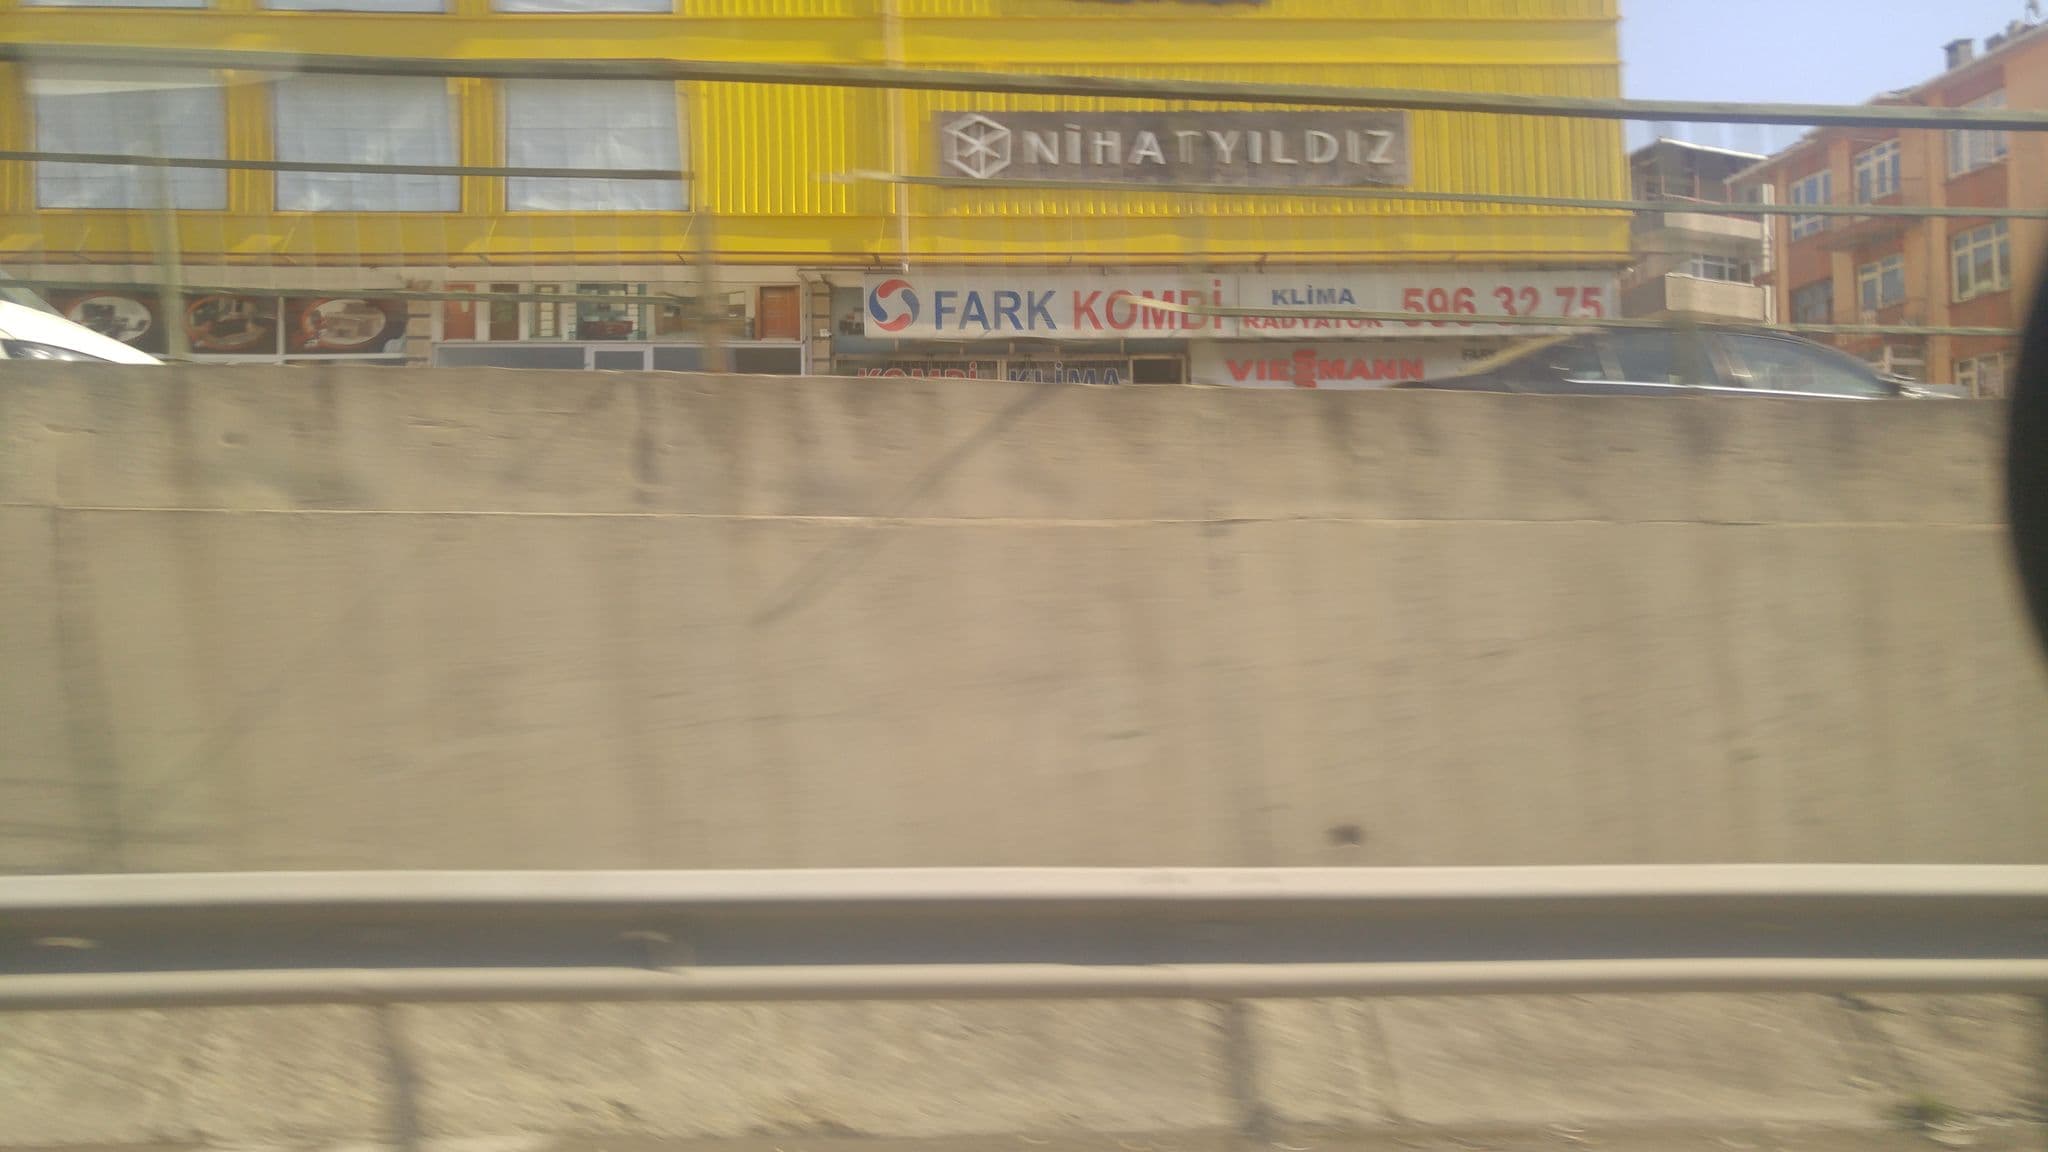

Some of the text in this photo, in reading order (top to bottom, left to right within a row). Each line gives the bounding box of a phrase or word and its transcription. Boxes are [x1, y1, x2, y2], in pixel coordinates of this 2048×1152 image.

[934, 279, 1223, 331] FARK KOMBİ
[1271, 284, 1357, 306] KLİMA
[1402, 286, 1604, 327] 596 32 75
